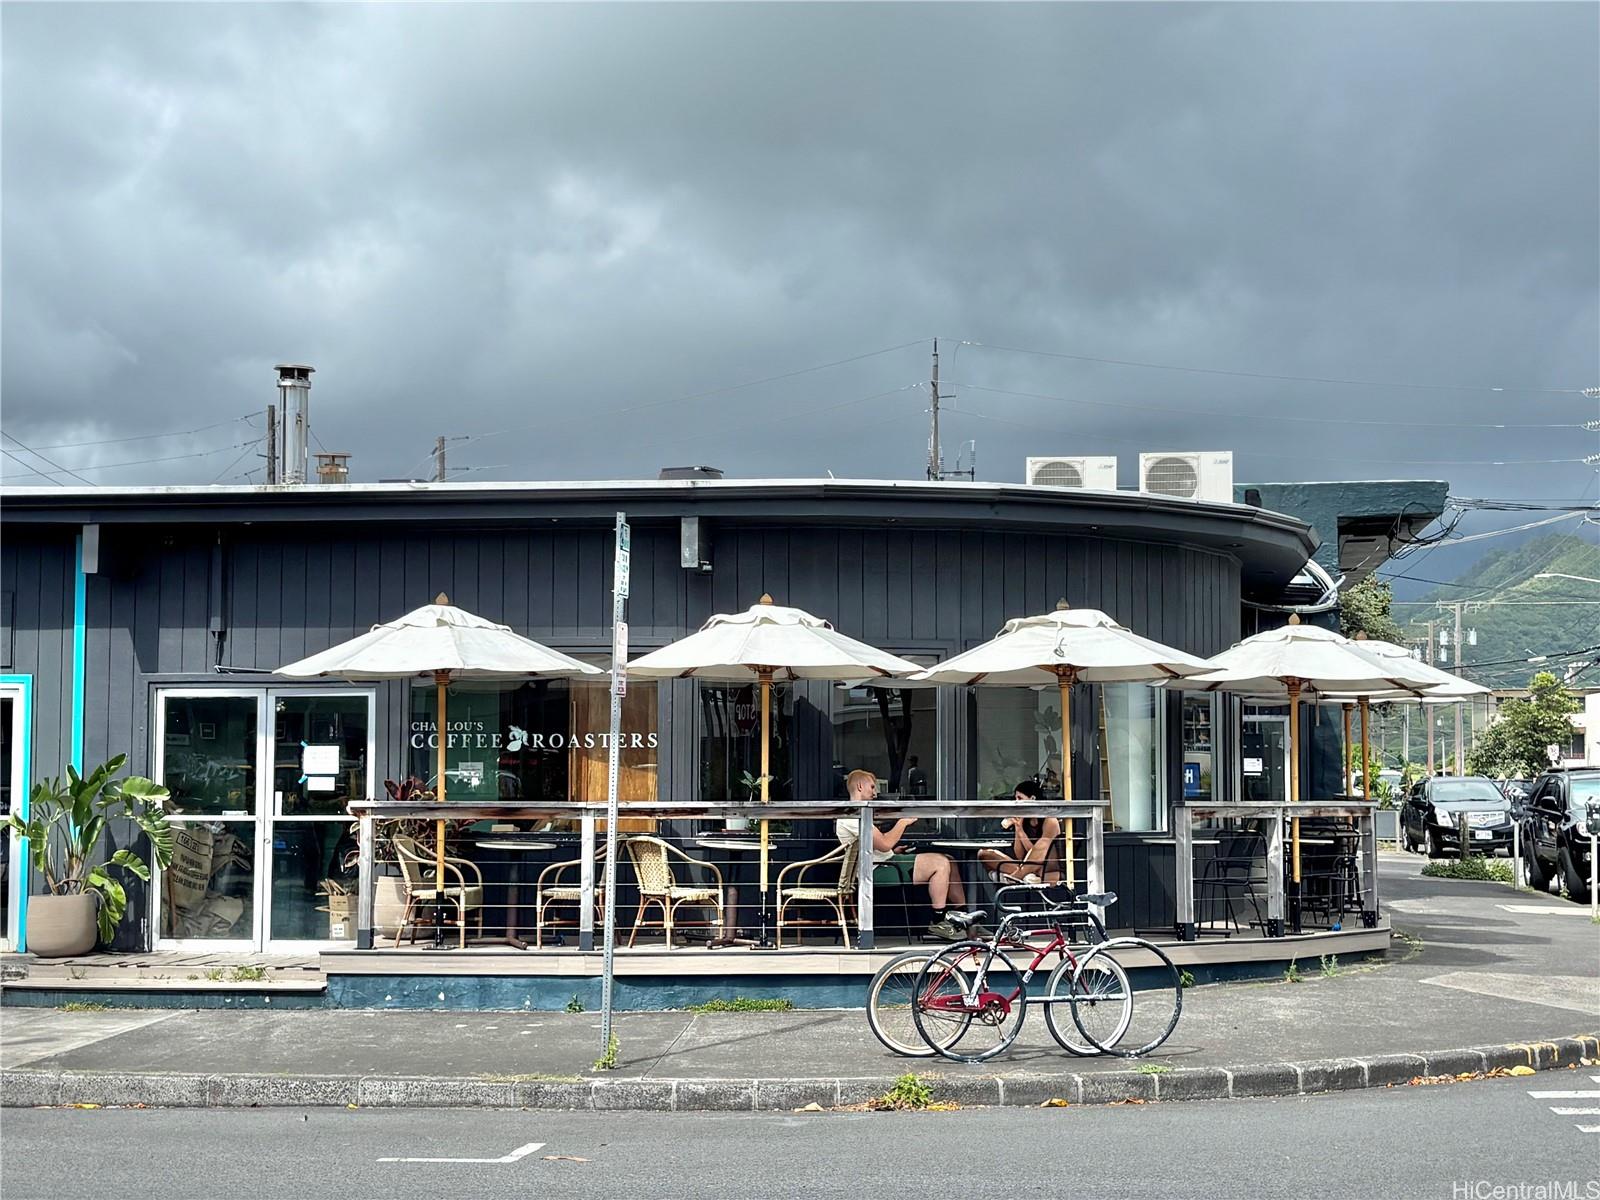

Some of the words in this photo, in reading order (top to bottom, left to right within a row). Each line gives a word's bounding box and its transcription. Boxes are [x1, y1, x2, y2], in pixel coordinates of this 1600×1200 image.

[411, 721, 484, 731] CHALOU'S
[411, 733, 503, 749] COFFEE
[532, 732, 658, 748] ROASTERS
